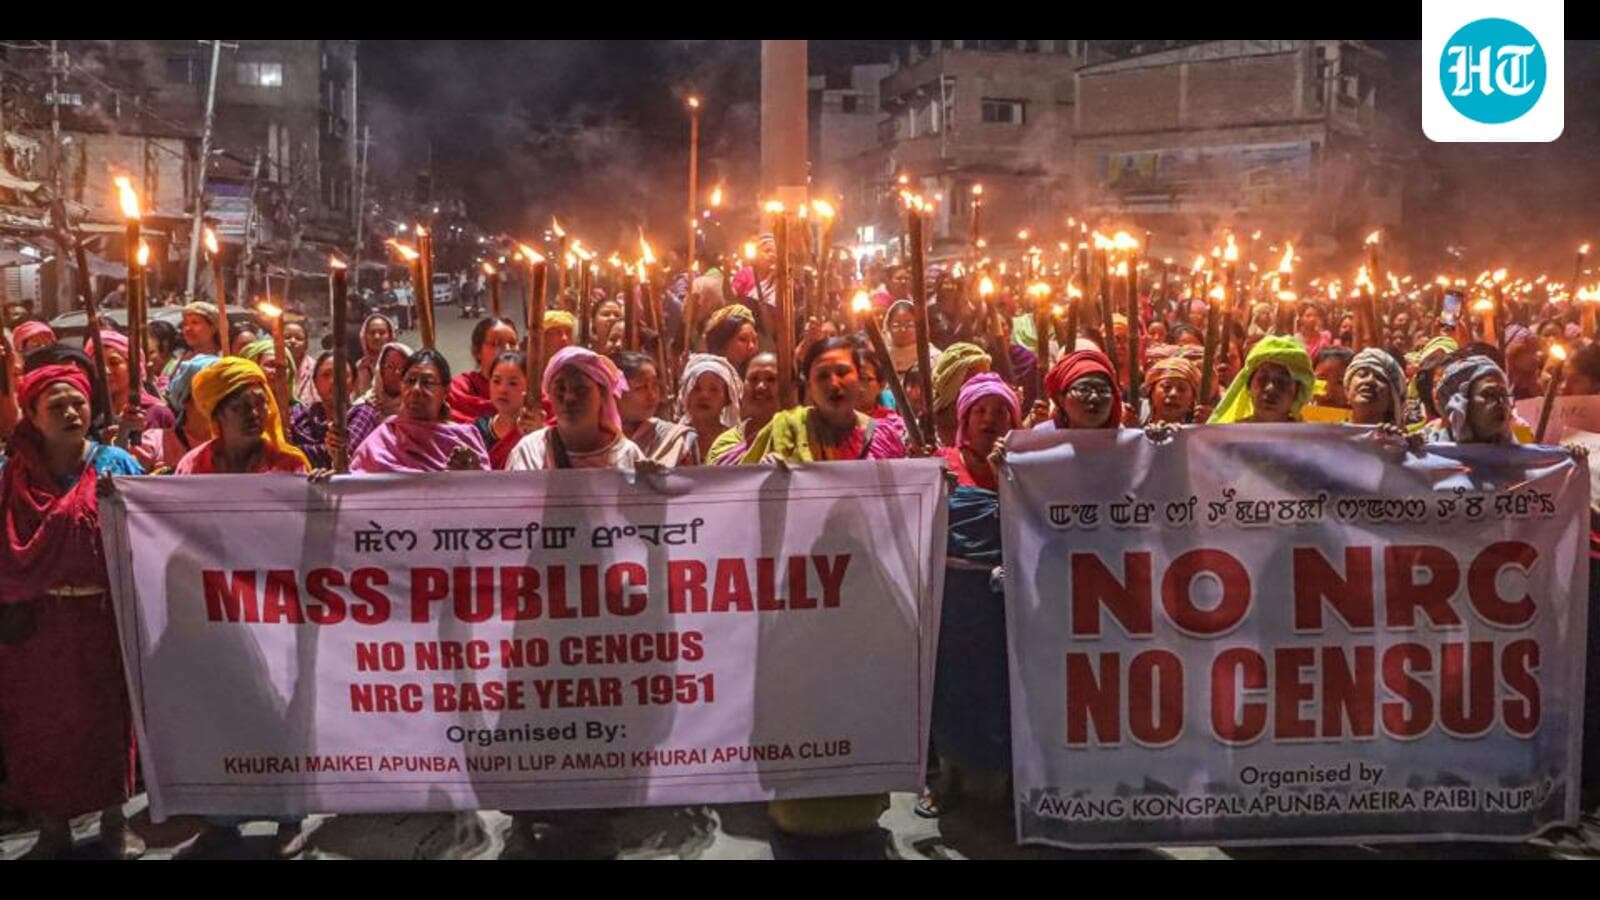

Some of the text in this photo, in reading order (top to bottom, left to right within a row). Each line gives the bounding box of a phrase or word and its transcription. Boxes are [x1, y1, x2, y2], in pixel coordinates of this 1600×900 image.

[203, 554, 850, 625] MASS PUBLIC RALLY
[1070, 540, 1538, 635] NO NRC
[357, 631, 704, 672] NO NRC NO CENCUS
[350, 673, 715, 712] NRC BASE YEAR 1951
[1067, 639, 1541, 746] NO CENSUS
[446, 721, 627, 747] Organised By:
[225, 740, 851, 774] KHURAI MAIKEI APUNBA NUPI LUP AMADI KHURAI APUNBA CLUB
[1240, 764, 1383, 788] Organised by
[1039, 795, 1124, 818] AWANG
[1133, 796, 1242, 816] KONGPAL
[1248, 788, 1342, 814] APUNBA
[1349, 790, 1415, 810] MEIRA
[1424, 789, 1476, 809] PAIBI
